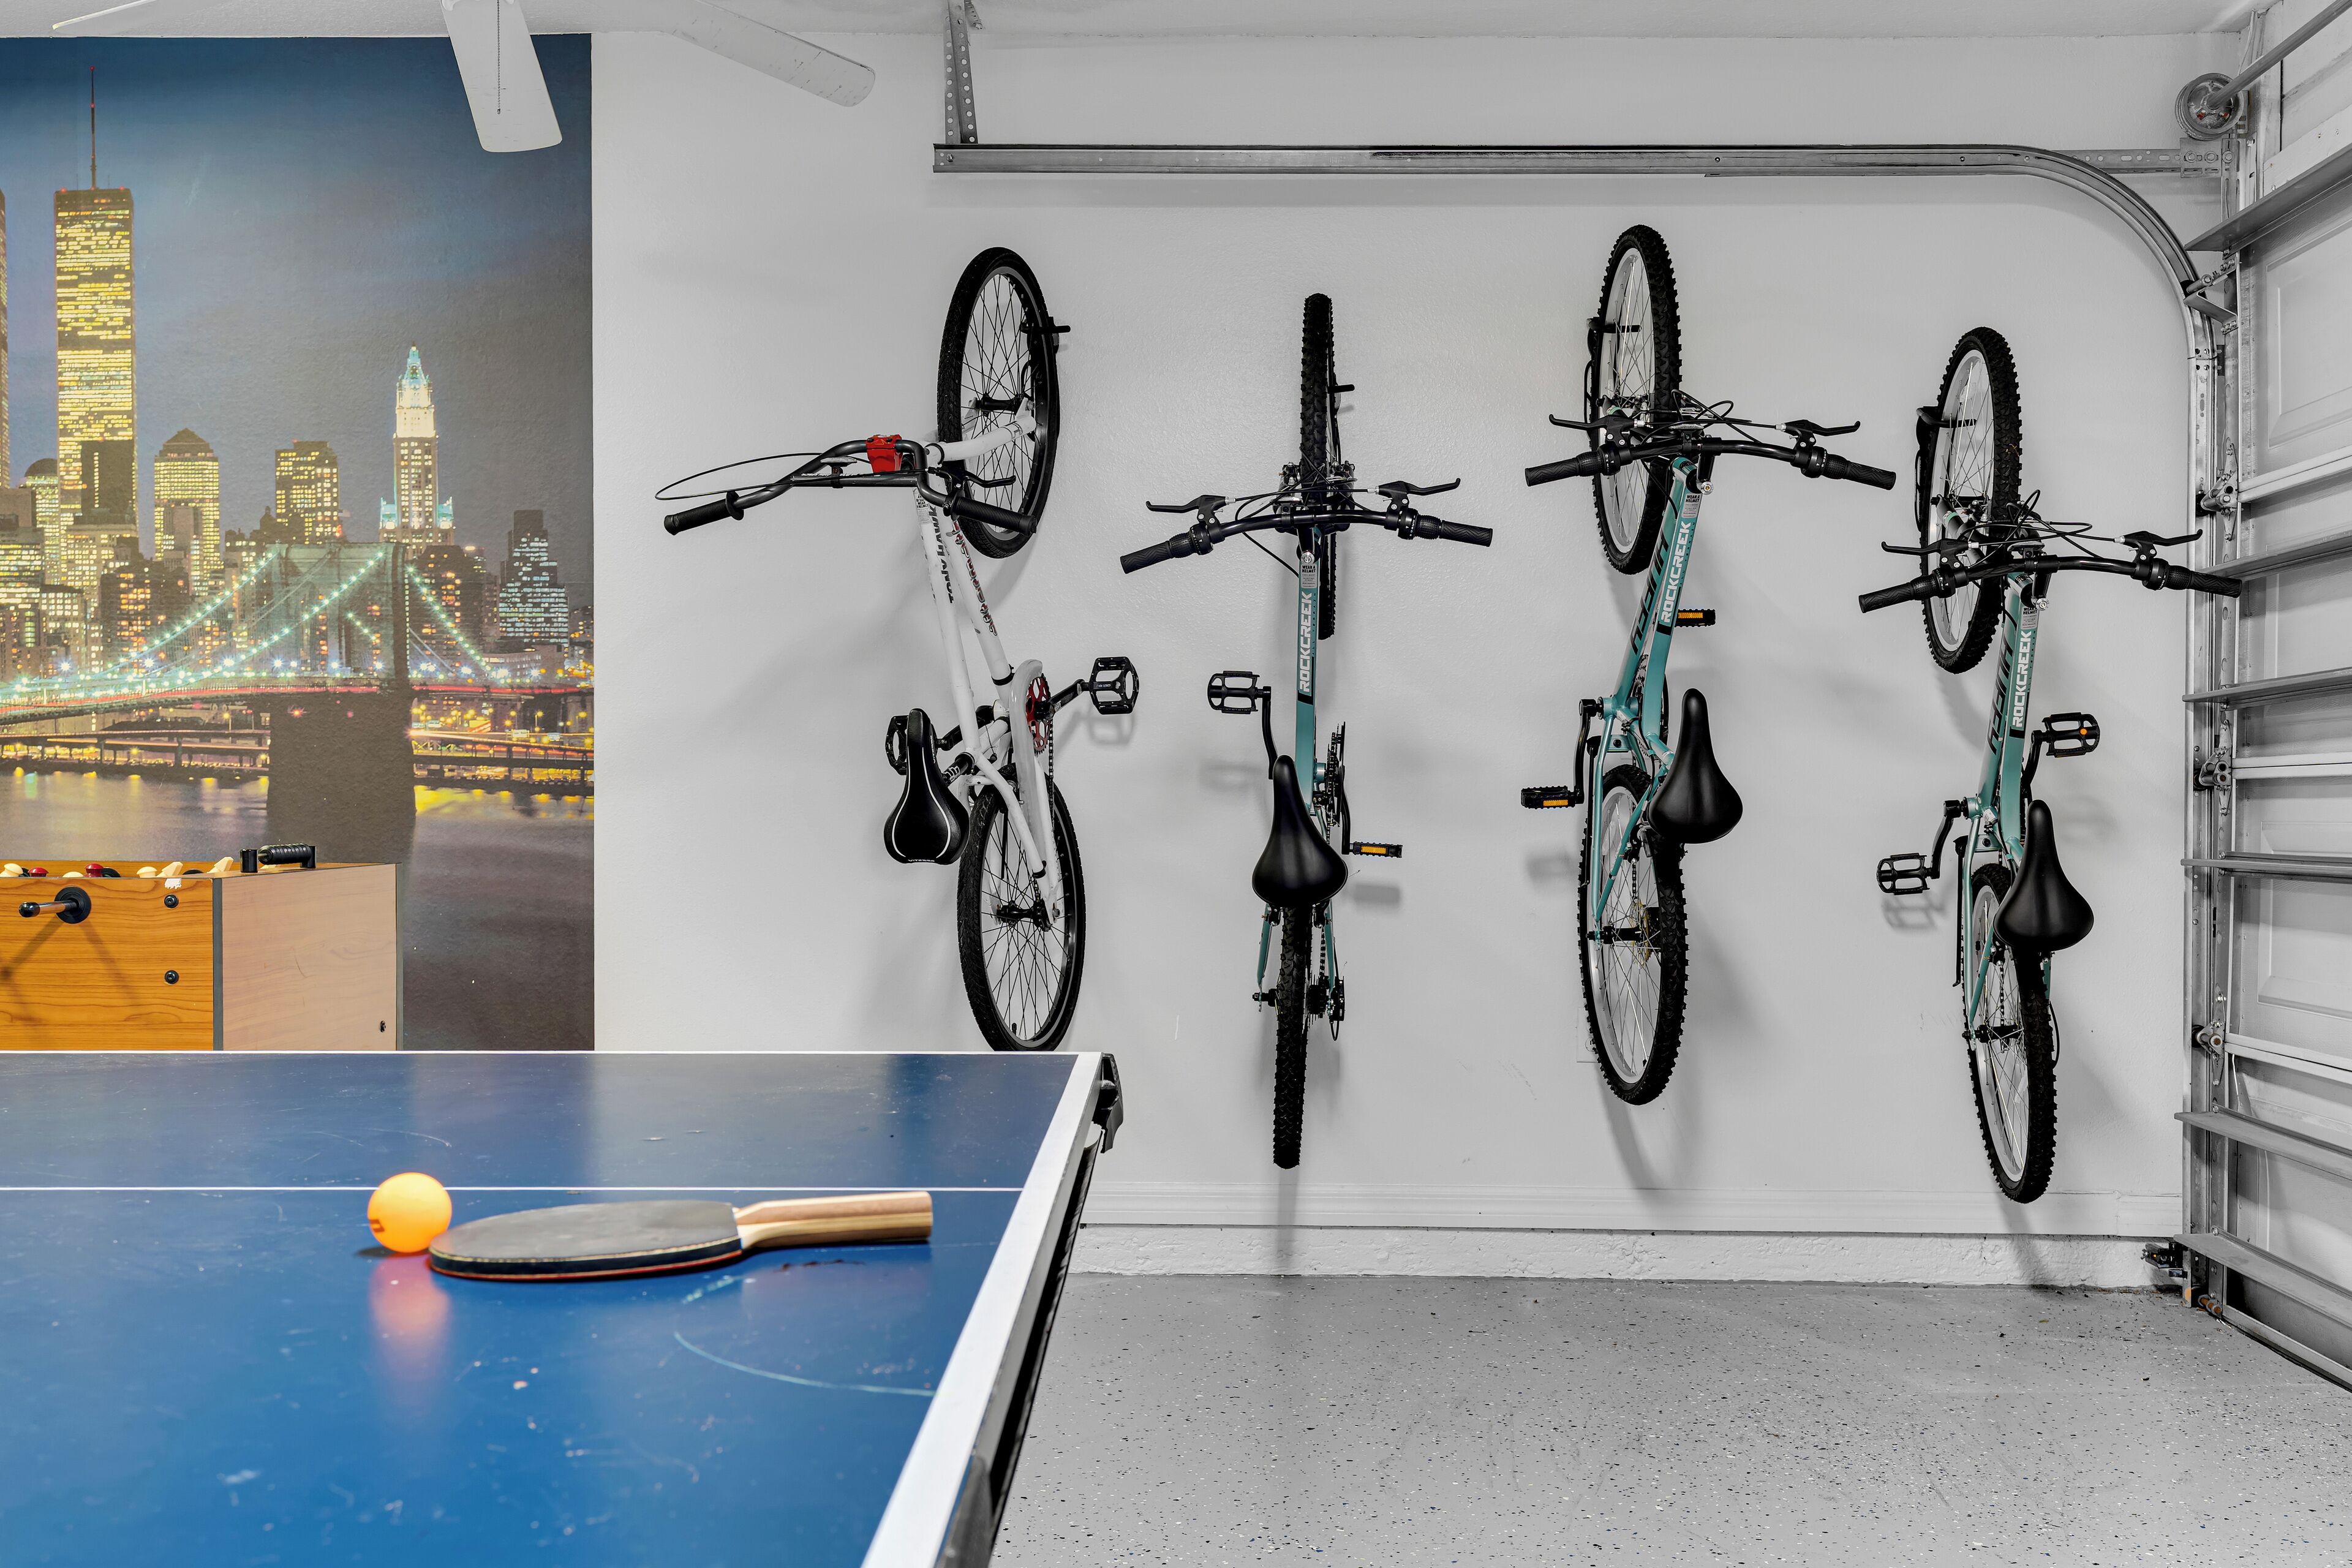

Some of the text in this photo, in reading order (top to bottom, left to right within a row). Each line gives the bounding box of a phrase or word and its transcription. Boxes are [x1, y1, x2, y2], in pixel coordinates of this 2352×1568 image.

[1630, 529, 1668, 655] HUFFY
[1660, 521, 1691, 623] ROCKCREEK
[1299, 591, 1312, 692] ROCKCREEK
[2012, 630, 2032, 728] ROCKCREEK
[1987, 635, 2013, 755] HUFFY
